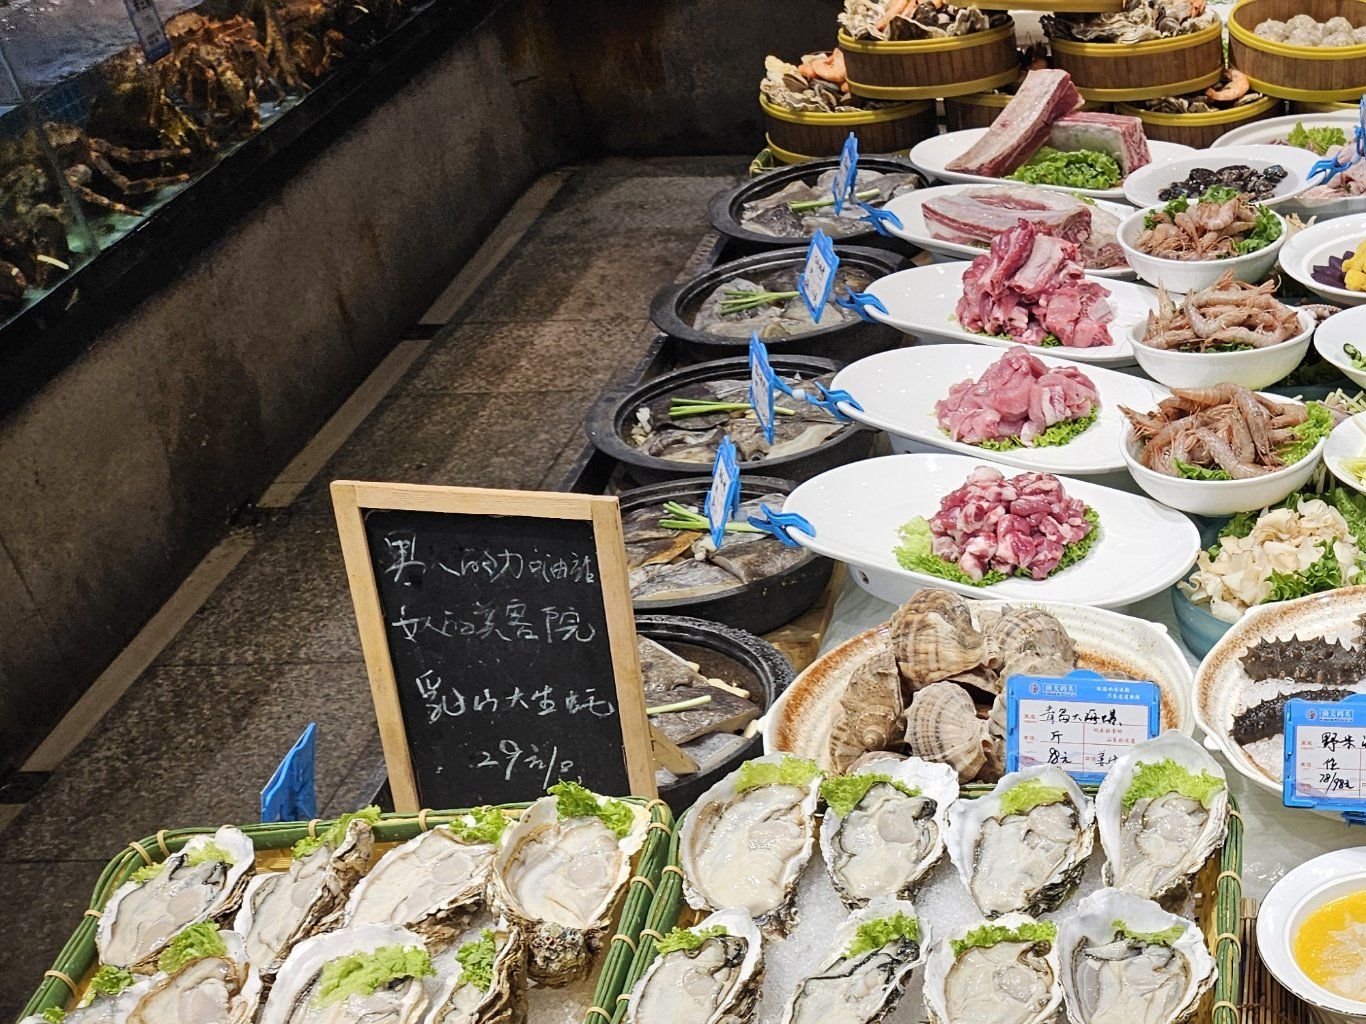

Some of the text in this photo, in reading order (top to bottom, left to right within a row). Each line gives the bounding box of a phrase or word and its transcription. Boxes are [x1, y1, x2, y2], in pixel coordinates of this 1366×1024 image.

[392, 599, 596, 643] 女人的美容院
[416, 670, 615, 724] 乳山大生蚝
[1051, 731, 1063, 744] 斤
[1323, 757, 1340, 770] 位
[1319, 772, 1354, 793] 78/98元
